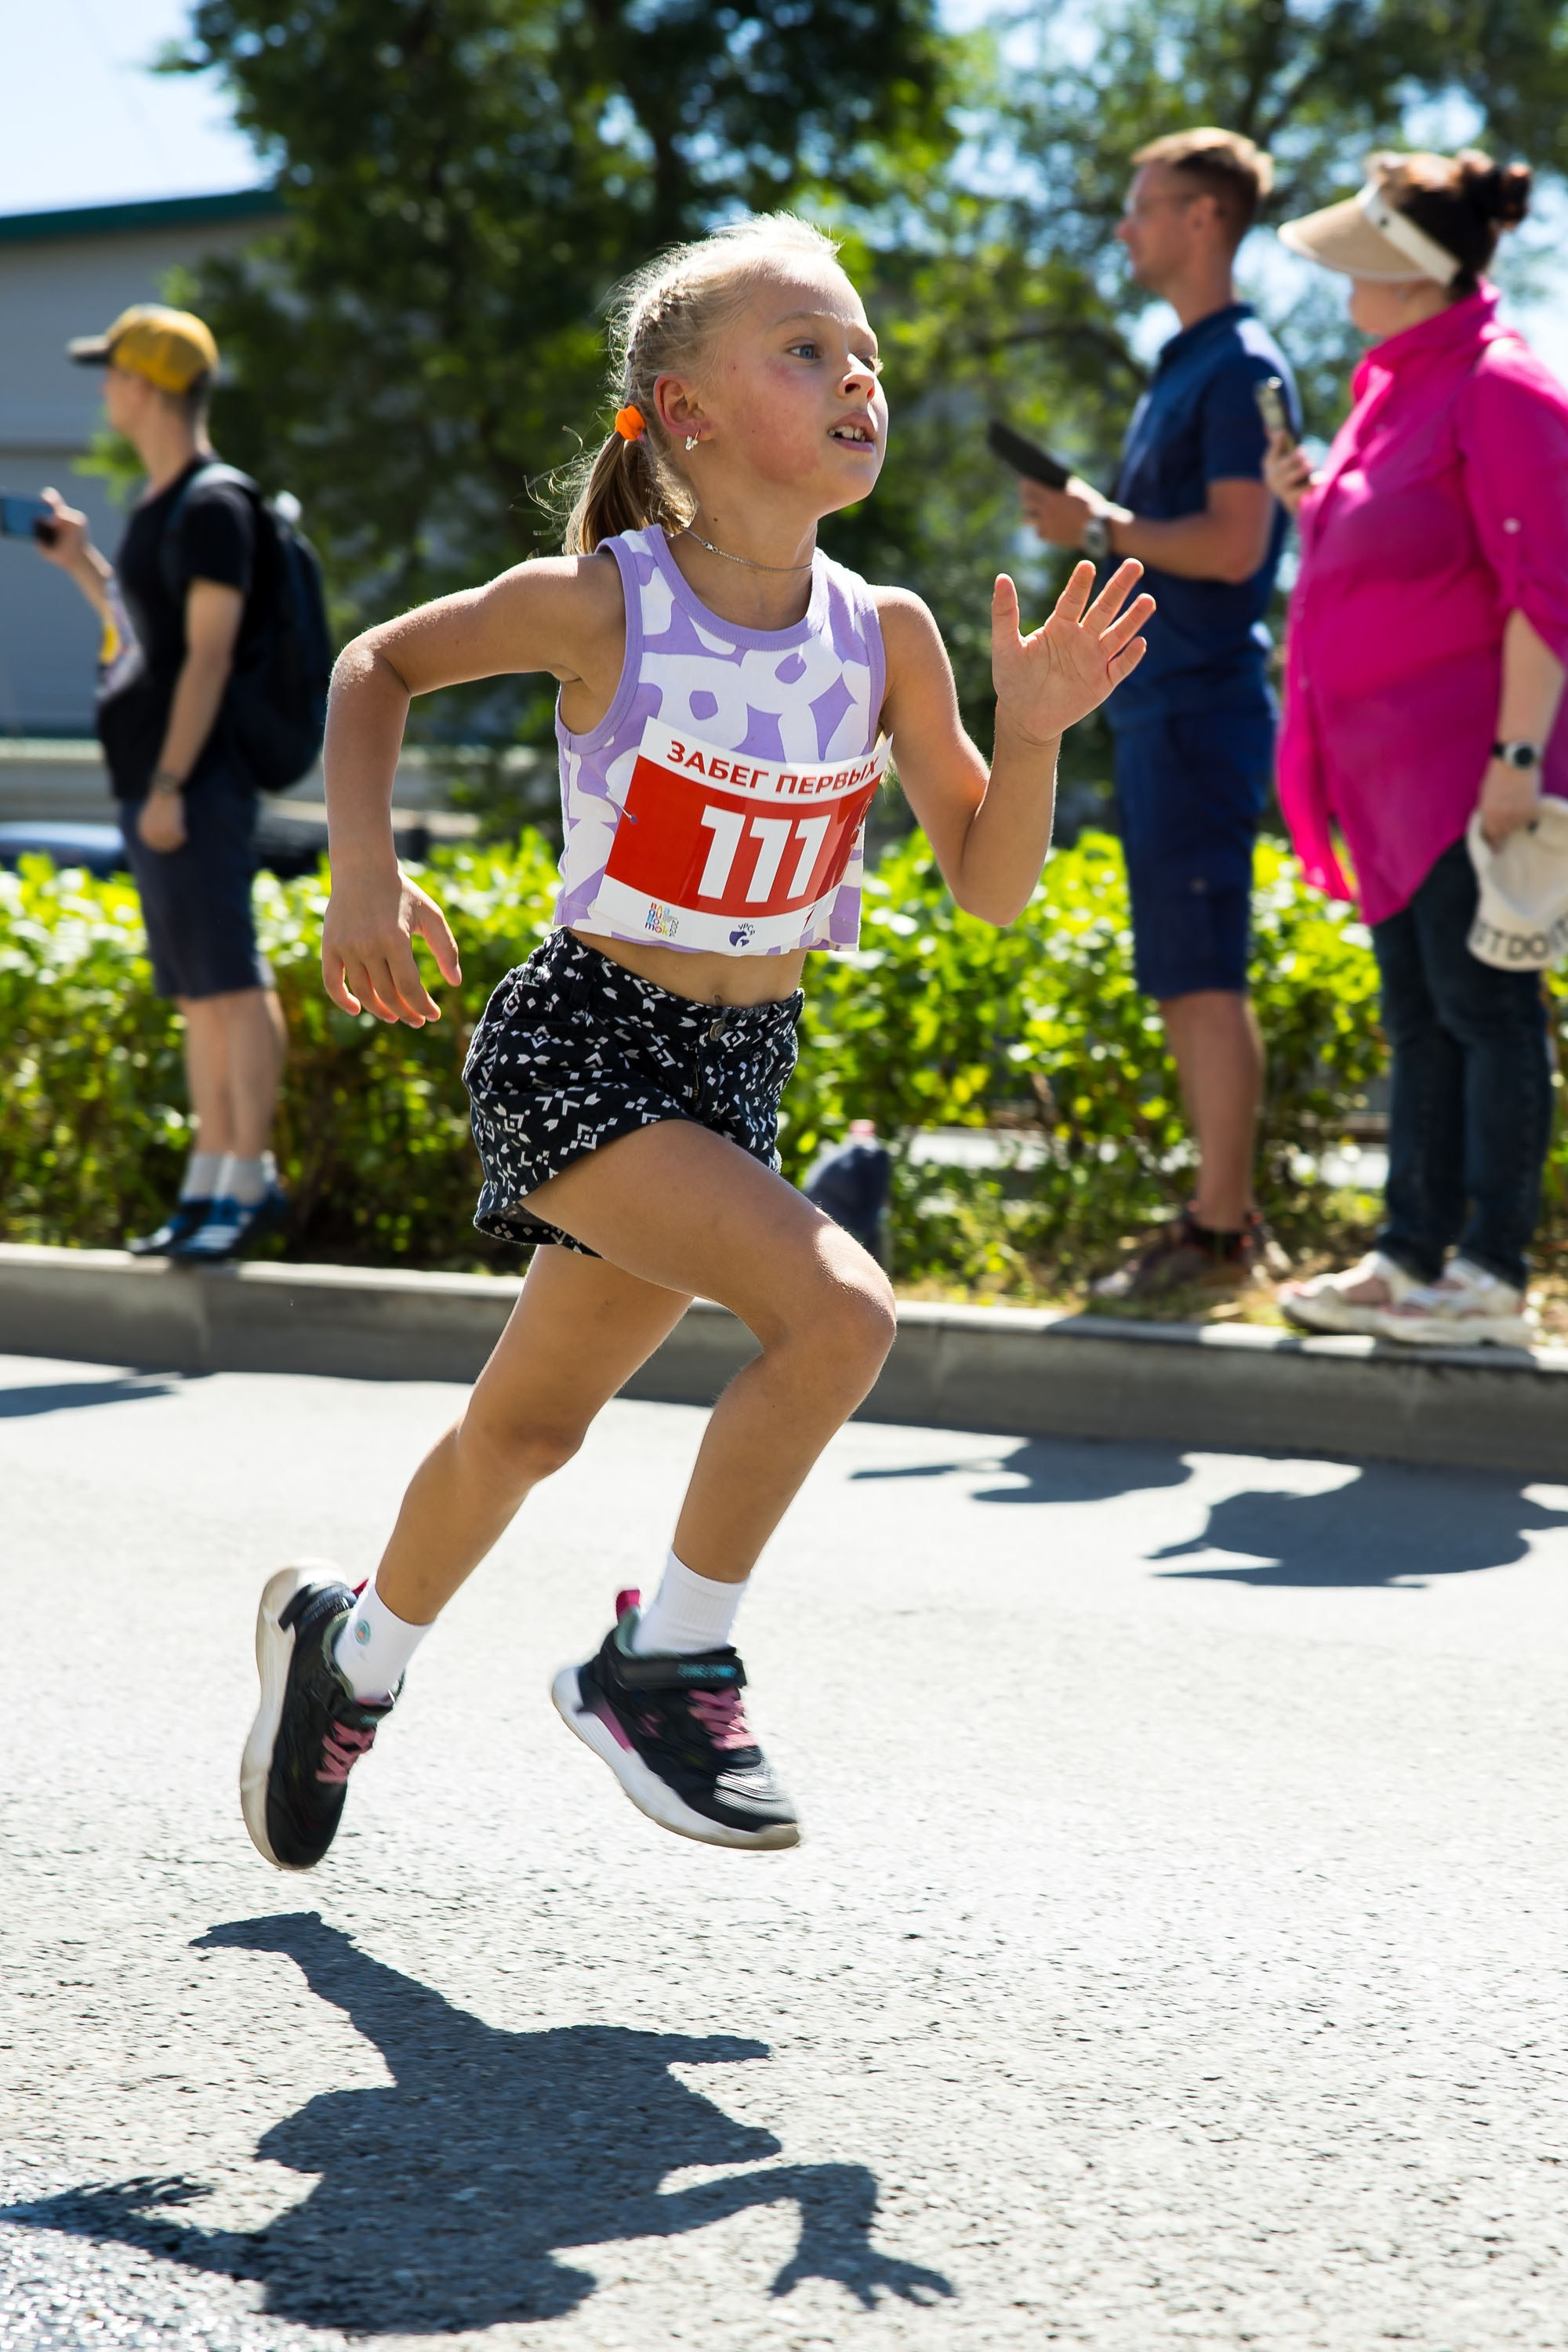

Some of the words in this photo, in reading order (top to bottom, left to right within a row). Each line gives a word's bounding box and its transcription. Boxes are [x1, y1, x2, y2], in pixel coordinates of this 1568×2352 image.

[666, 739, 769, 789] ЗАБЕГ
[775, 755, 880, 795] ПЕРВЫХ
[697, 804, 831, 903] 111
